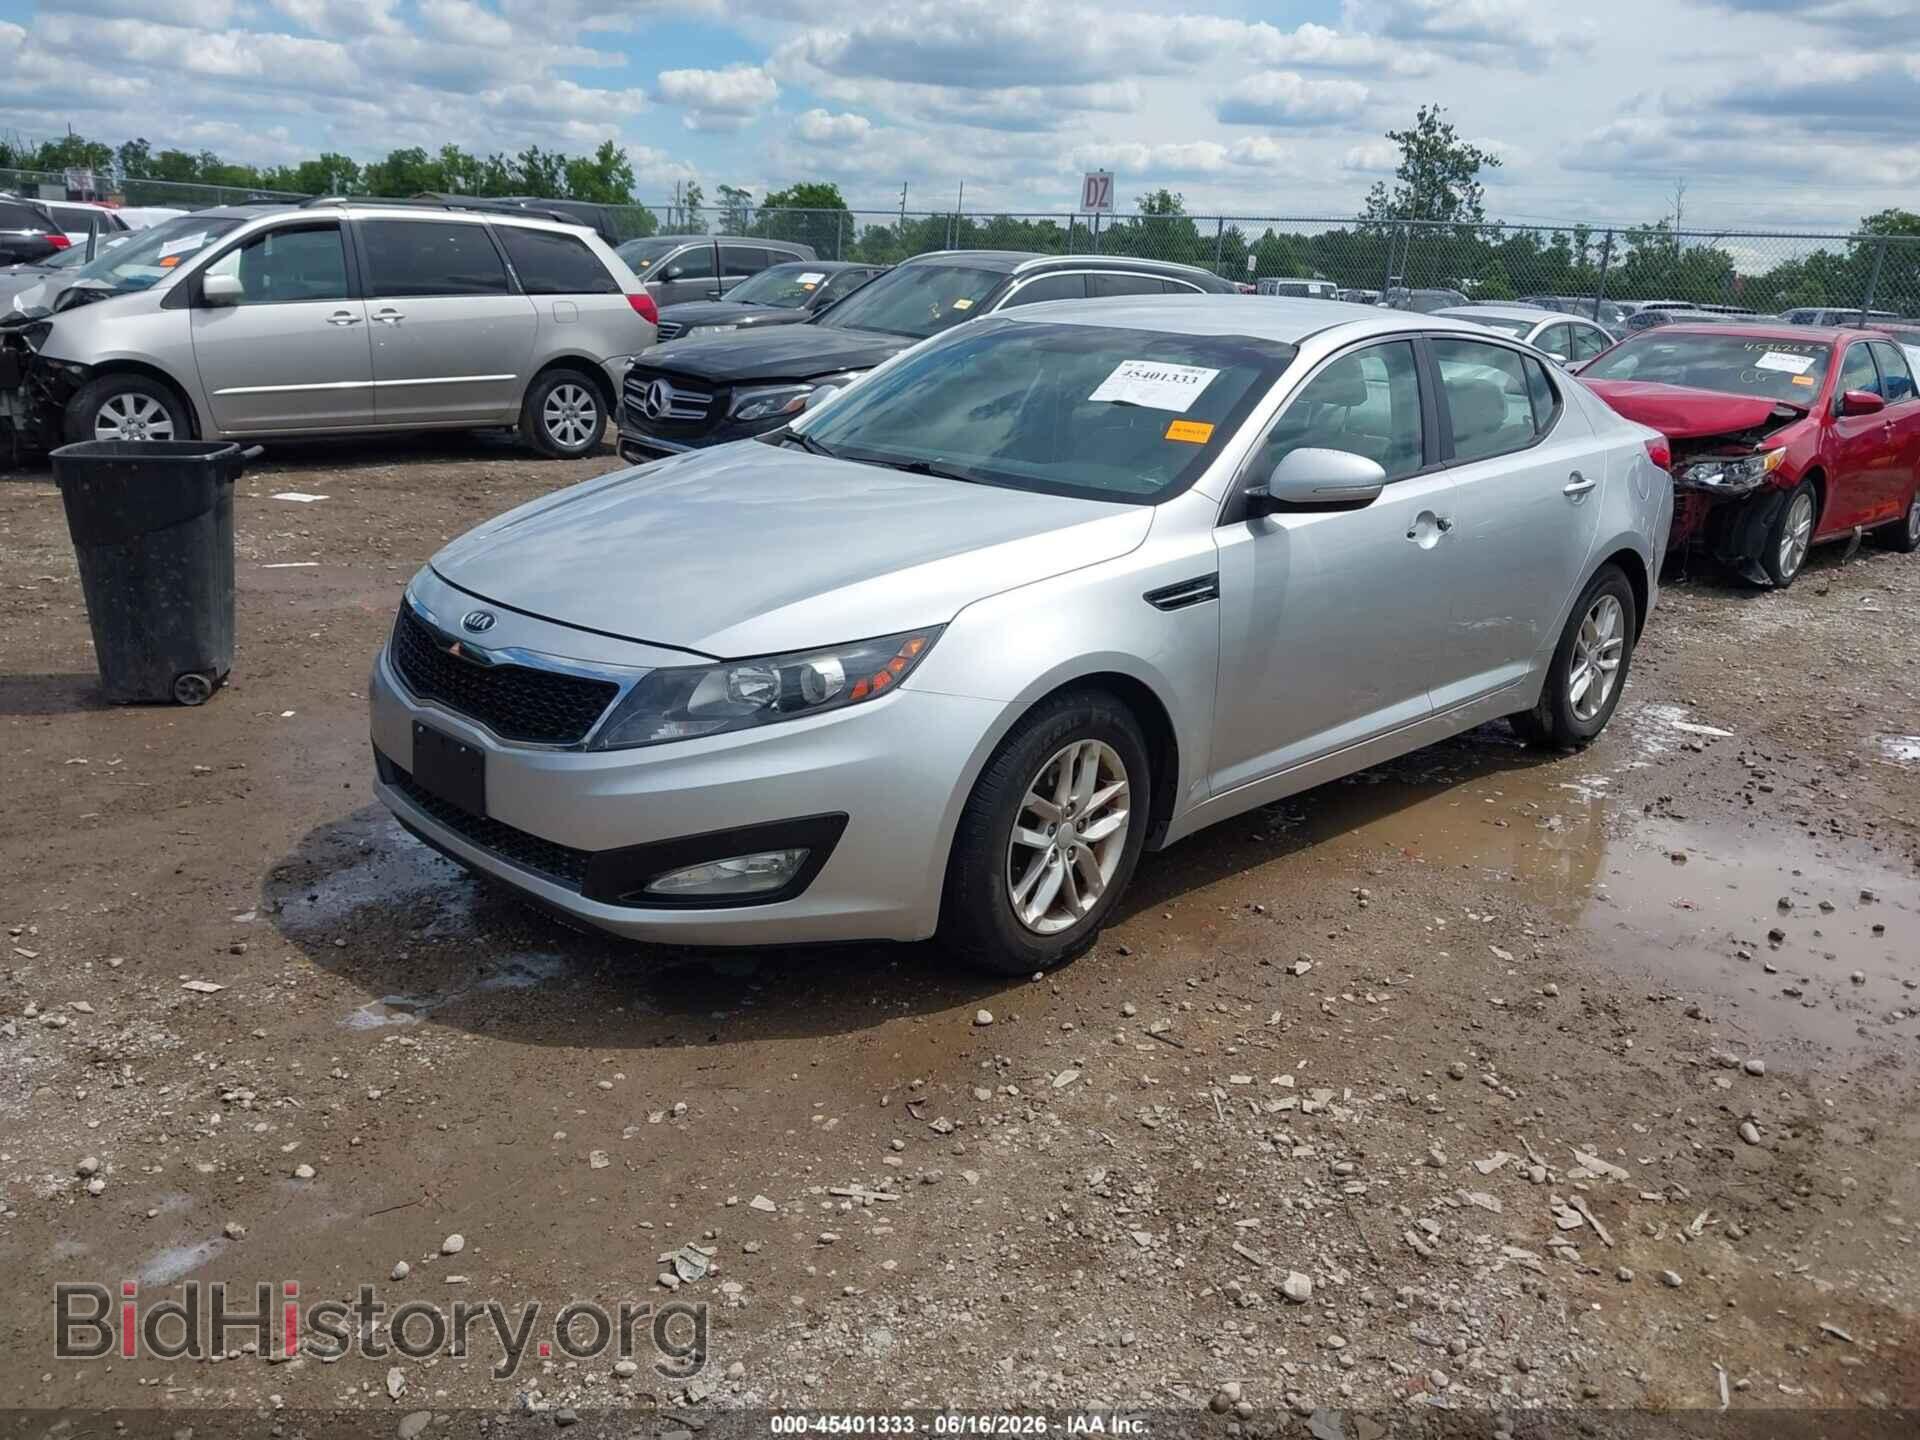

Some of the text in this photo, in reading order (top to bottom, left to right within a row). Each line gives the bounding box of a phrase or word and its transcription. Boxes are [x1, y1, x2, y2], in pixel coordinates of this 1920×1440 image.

[1085, 177, 1109, 207] DZ
[1121, 369, 1199, 384] 45401333
[465, 612, 490, 630] KIA
